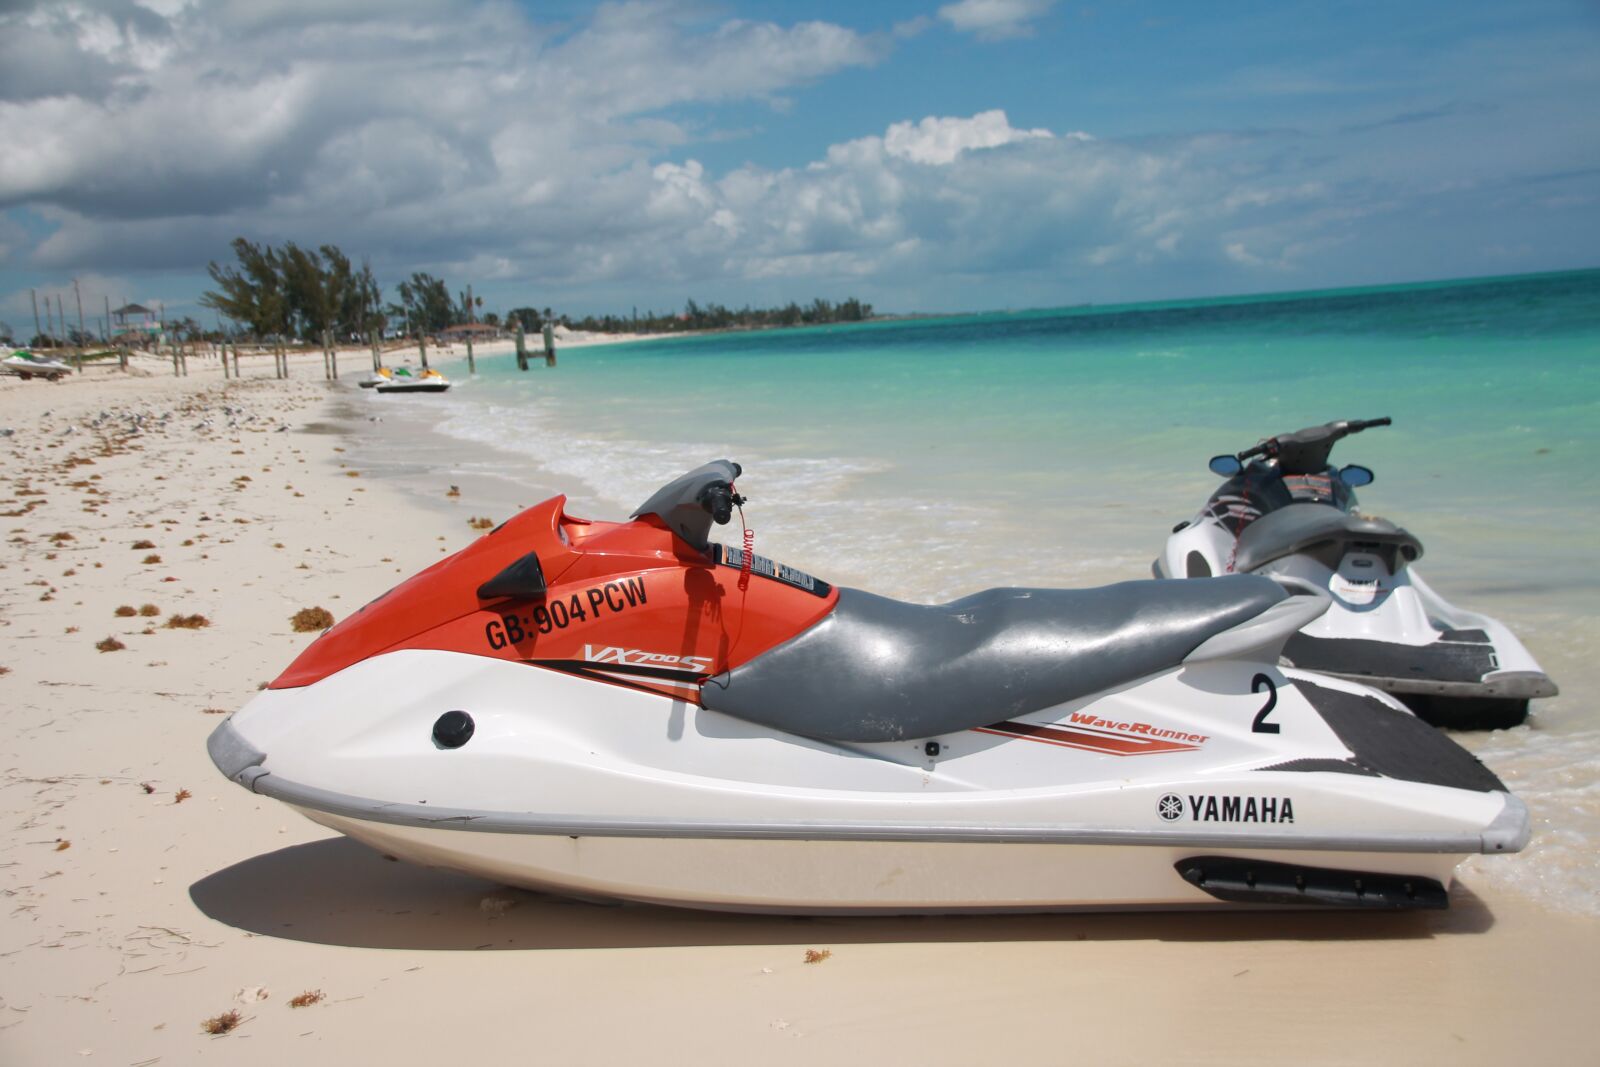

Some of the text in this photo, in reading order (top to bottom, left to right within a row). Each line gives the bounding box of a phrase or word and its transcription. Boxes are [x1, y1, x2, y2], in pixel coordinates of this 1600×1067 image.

[586, 576, 647, 618] PCW
[1251, 672, 1280, 734] 2
[1070, 712, 1209, 743] WaveRunner
[1188, 795, 1295, 824] YAMAHA
